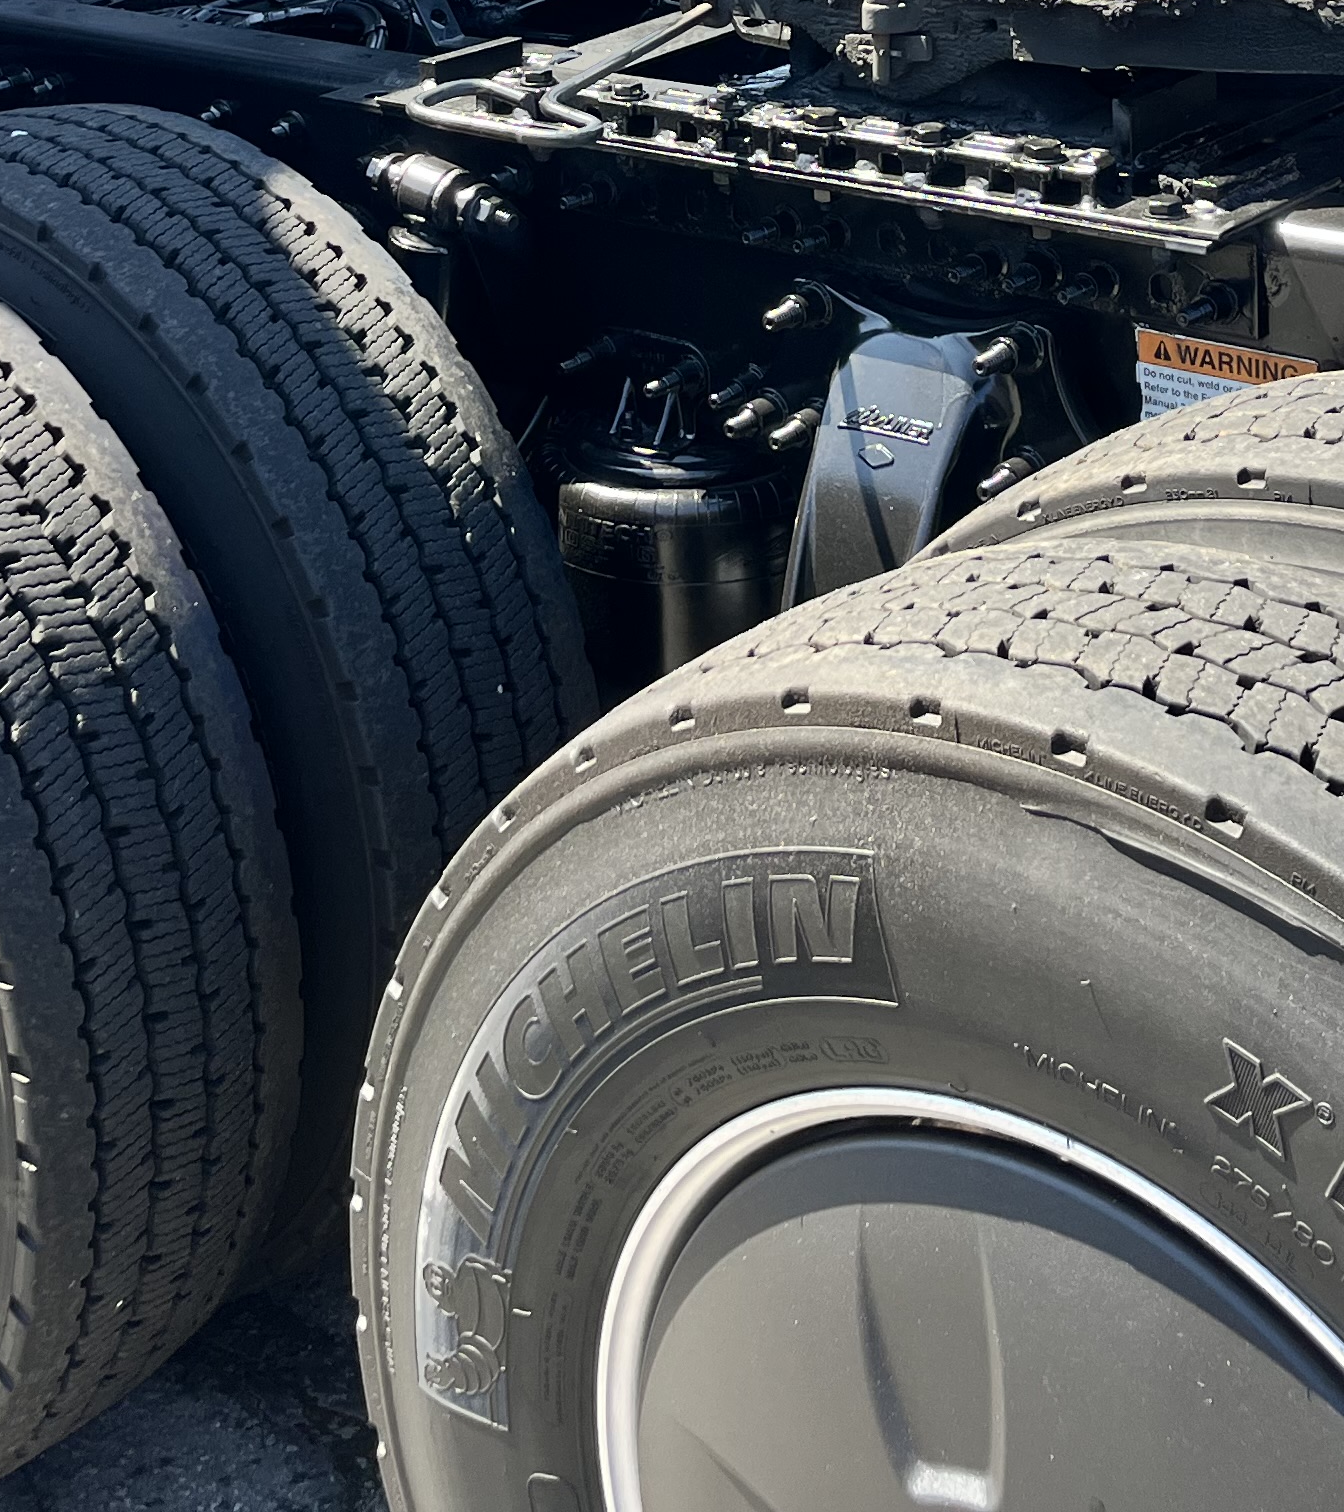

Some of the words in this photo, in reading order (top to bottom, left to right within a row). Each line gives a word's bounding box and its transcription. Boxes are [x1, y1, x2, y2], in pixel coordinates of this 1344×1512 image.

[1143, 367, 1157, 378] Do
[1158, 370, 1174, 382] not
[1197, 379, 1220, 391] weld
[1144, 381, 1168, 395] Refer
[1171, 386, 1180, 397] to
[1183, 388, 1199, 401] the
[1176, 342, 1299, 381] WARNING
[1144, 395, 1178, 410] Manual
[439, 874, 861, 1247] MICHELIN
[1022, 1044, 1178, 1135] MICHELIN
[1204, 1037, 1312, 1162] X
[1210, 1155, 1335, 1266] 275/80
